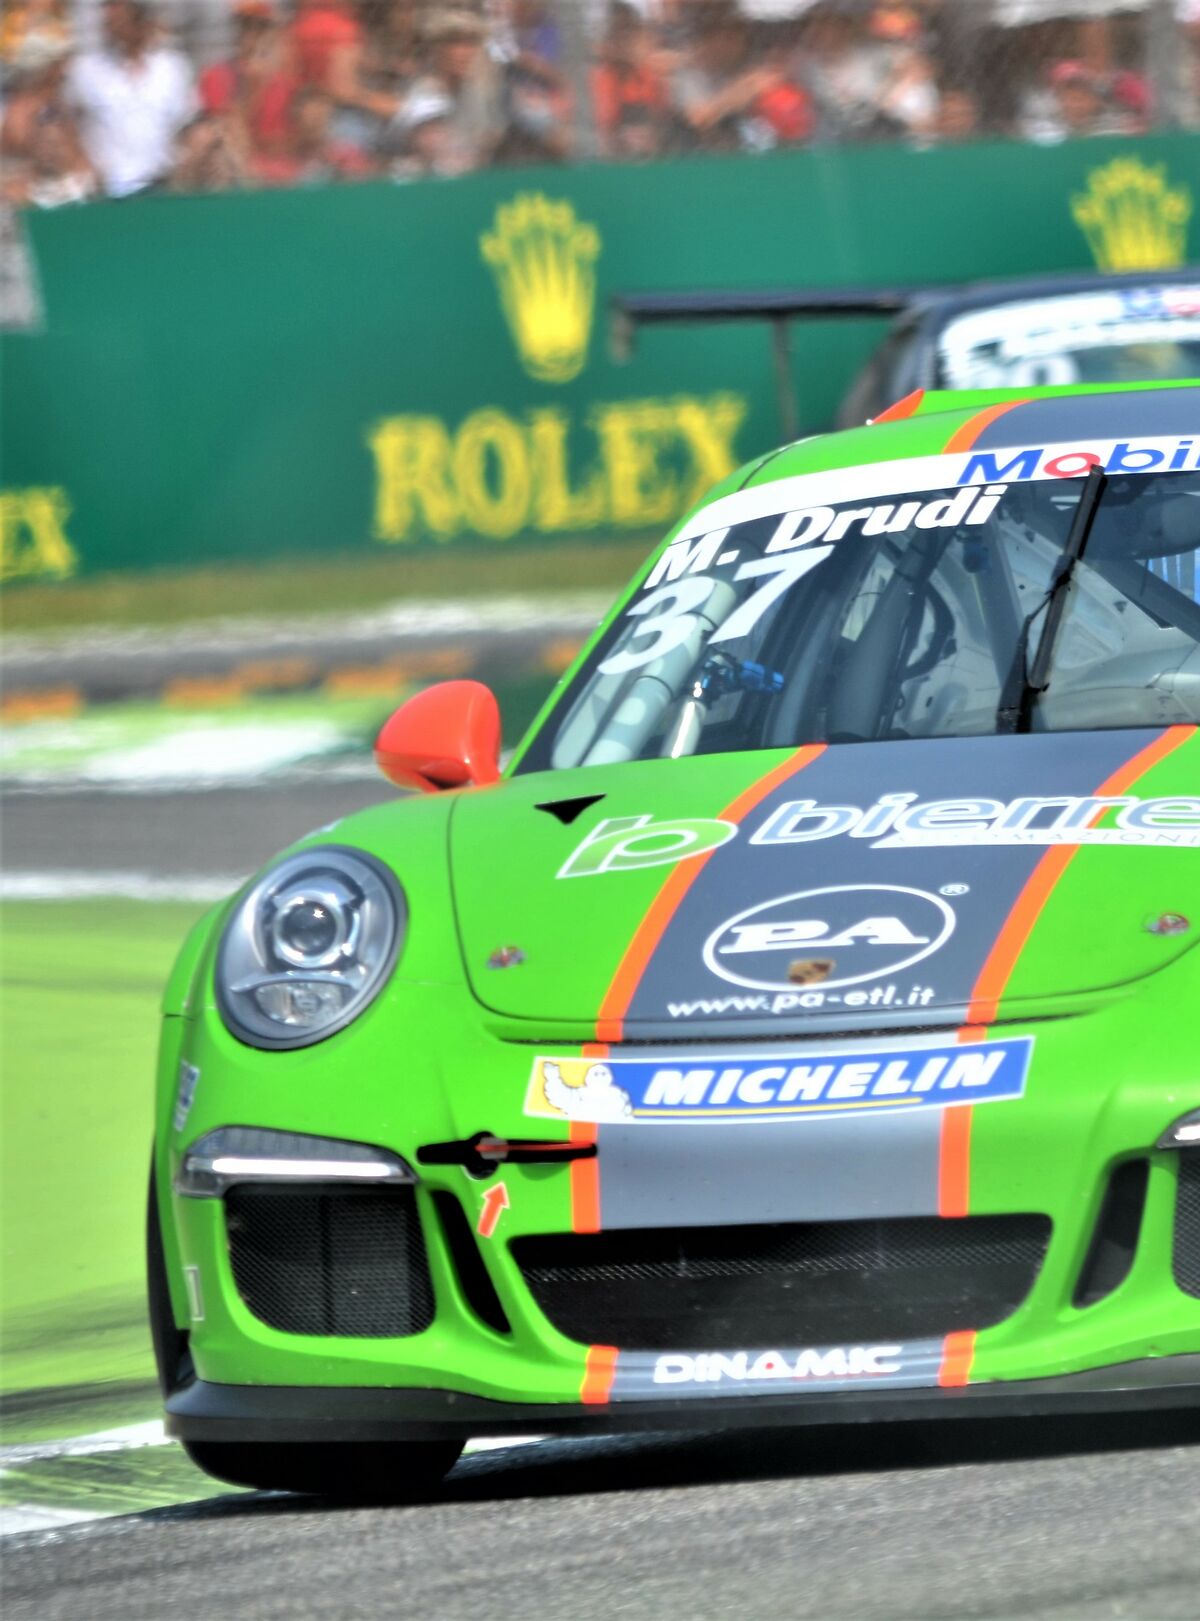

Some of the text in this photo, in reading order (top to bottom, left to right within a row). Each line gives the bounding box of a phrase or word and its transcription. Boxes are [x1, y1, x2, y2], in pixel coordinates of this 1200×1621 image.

[368, 393, 746, 543] ROLEX
[644, 485, 1008, 589] M. Drudi
[598, 545, 836, 675] 37
[719, 917, 930, 953] PA
[643, 1051, 1007, 1105] MICHELIN
[653, 1346, 903, 1384] DINAMIC
